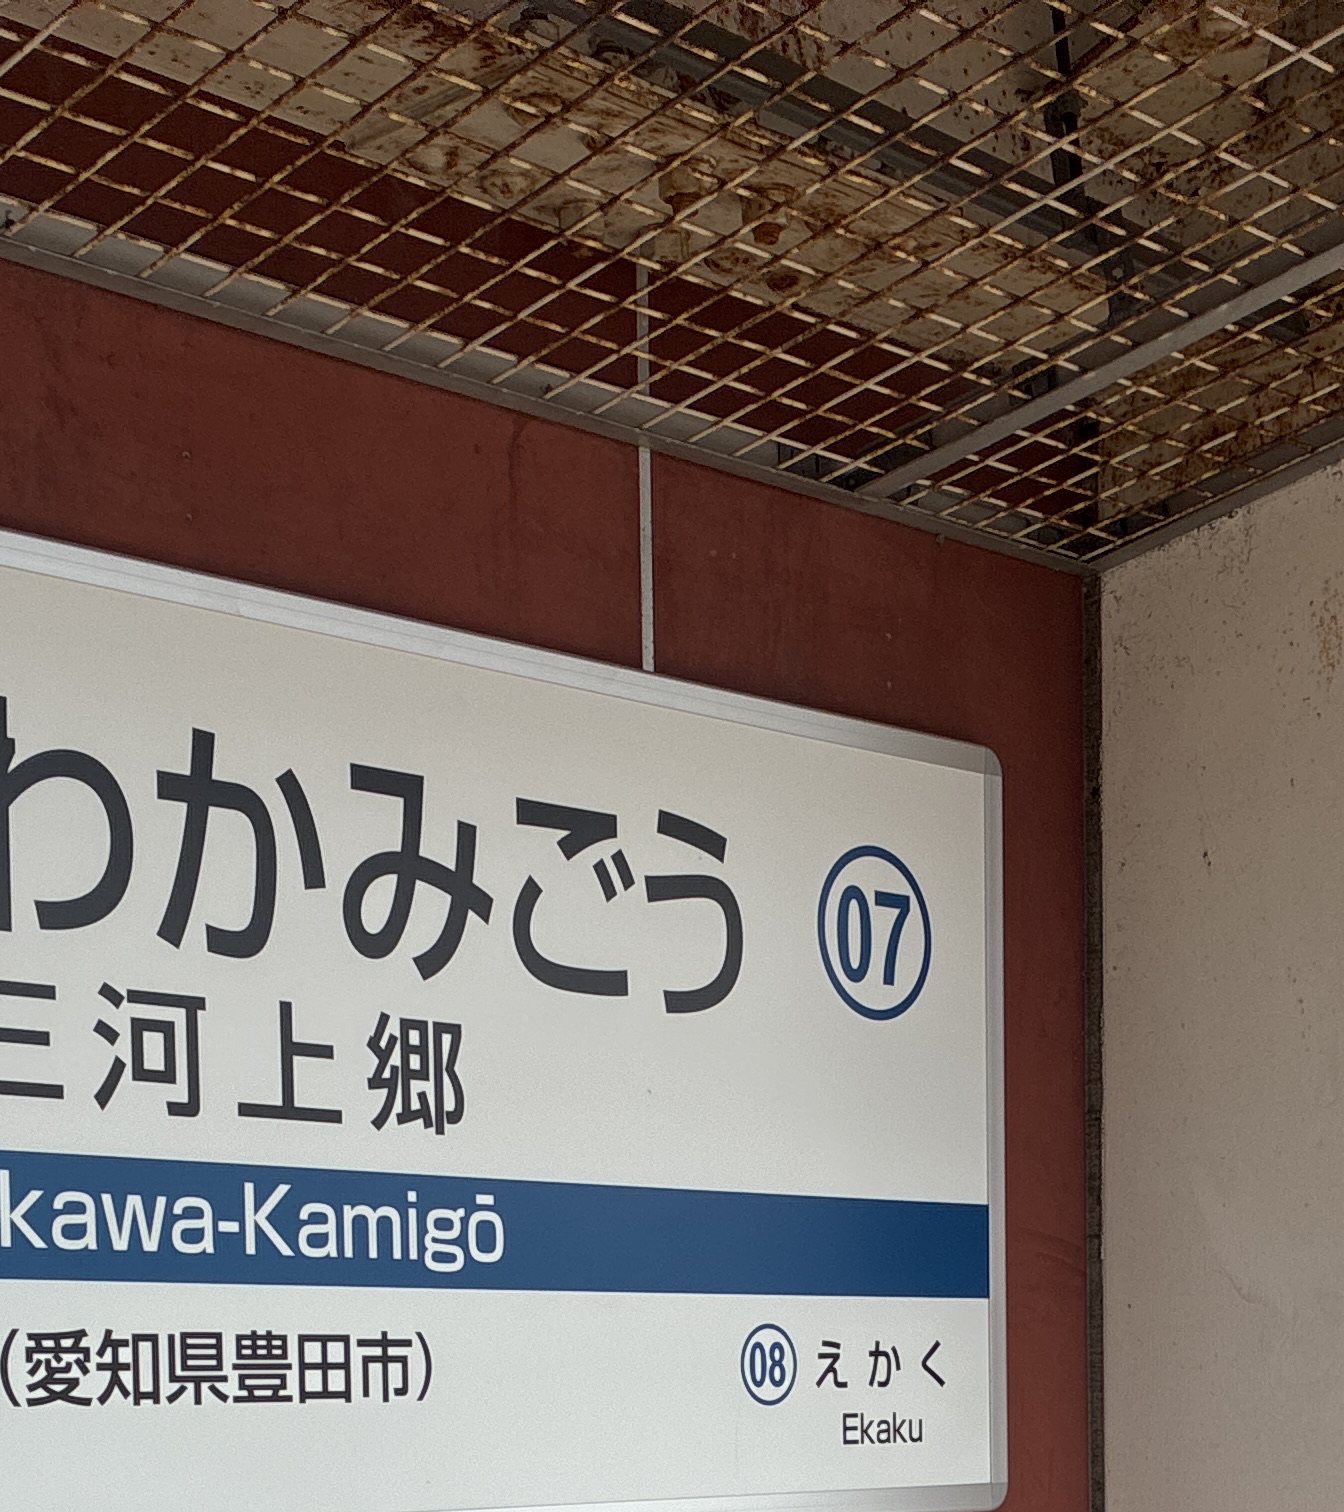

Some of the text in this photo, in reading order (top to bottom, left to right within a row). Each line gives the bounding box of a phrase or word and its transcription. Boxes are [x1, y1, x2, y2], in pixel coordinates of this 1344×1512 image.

[835, 884, 911, 986] 07
[749, 1340, 946, 1388] 08 えかく
[842, 1412, 923, 1445] Ekaku
